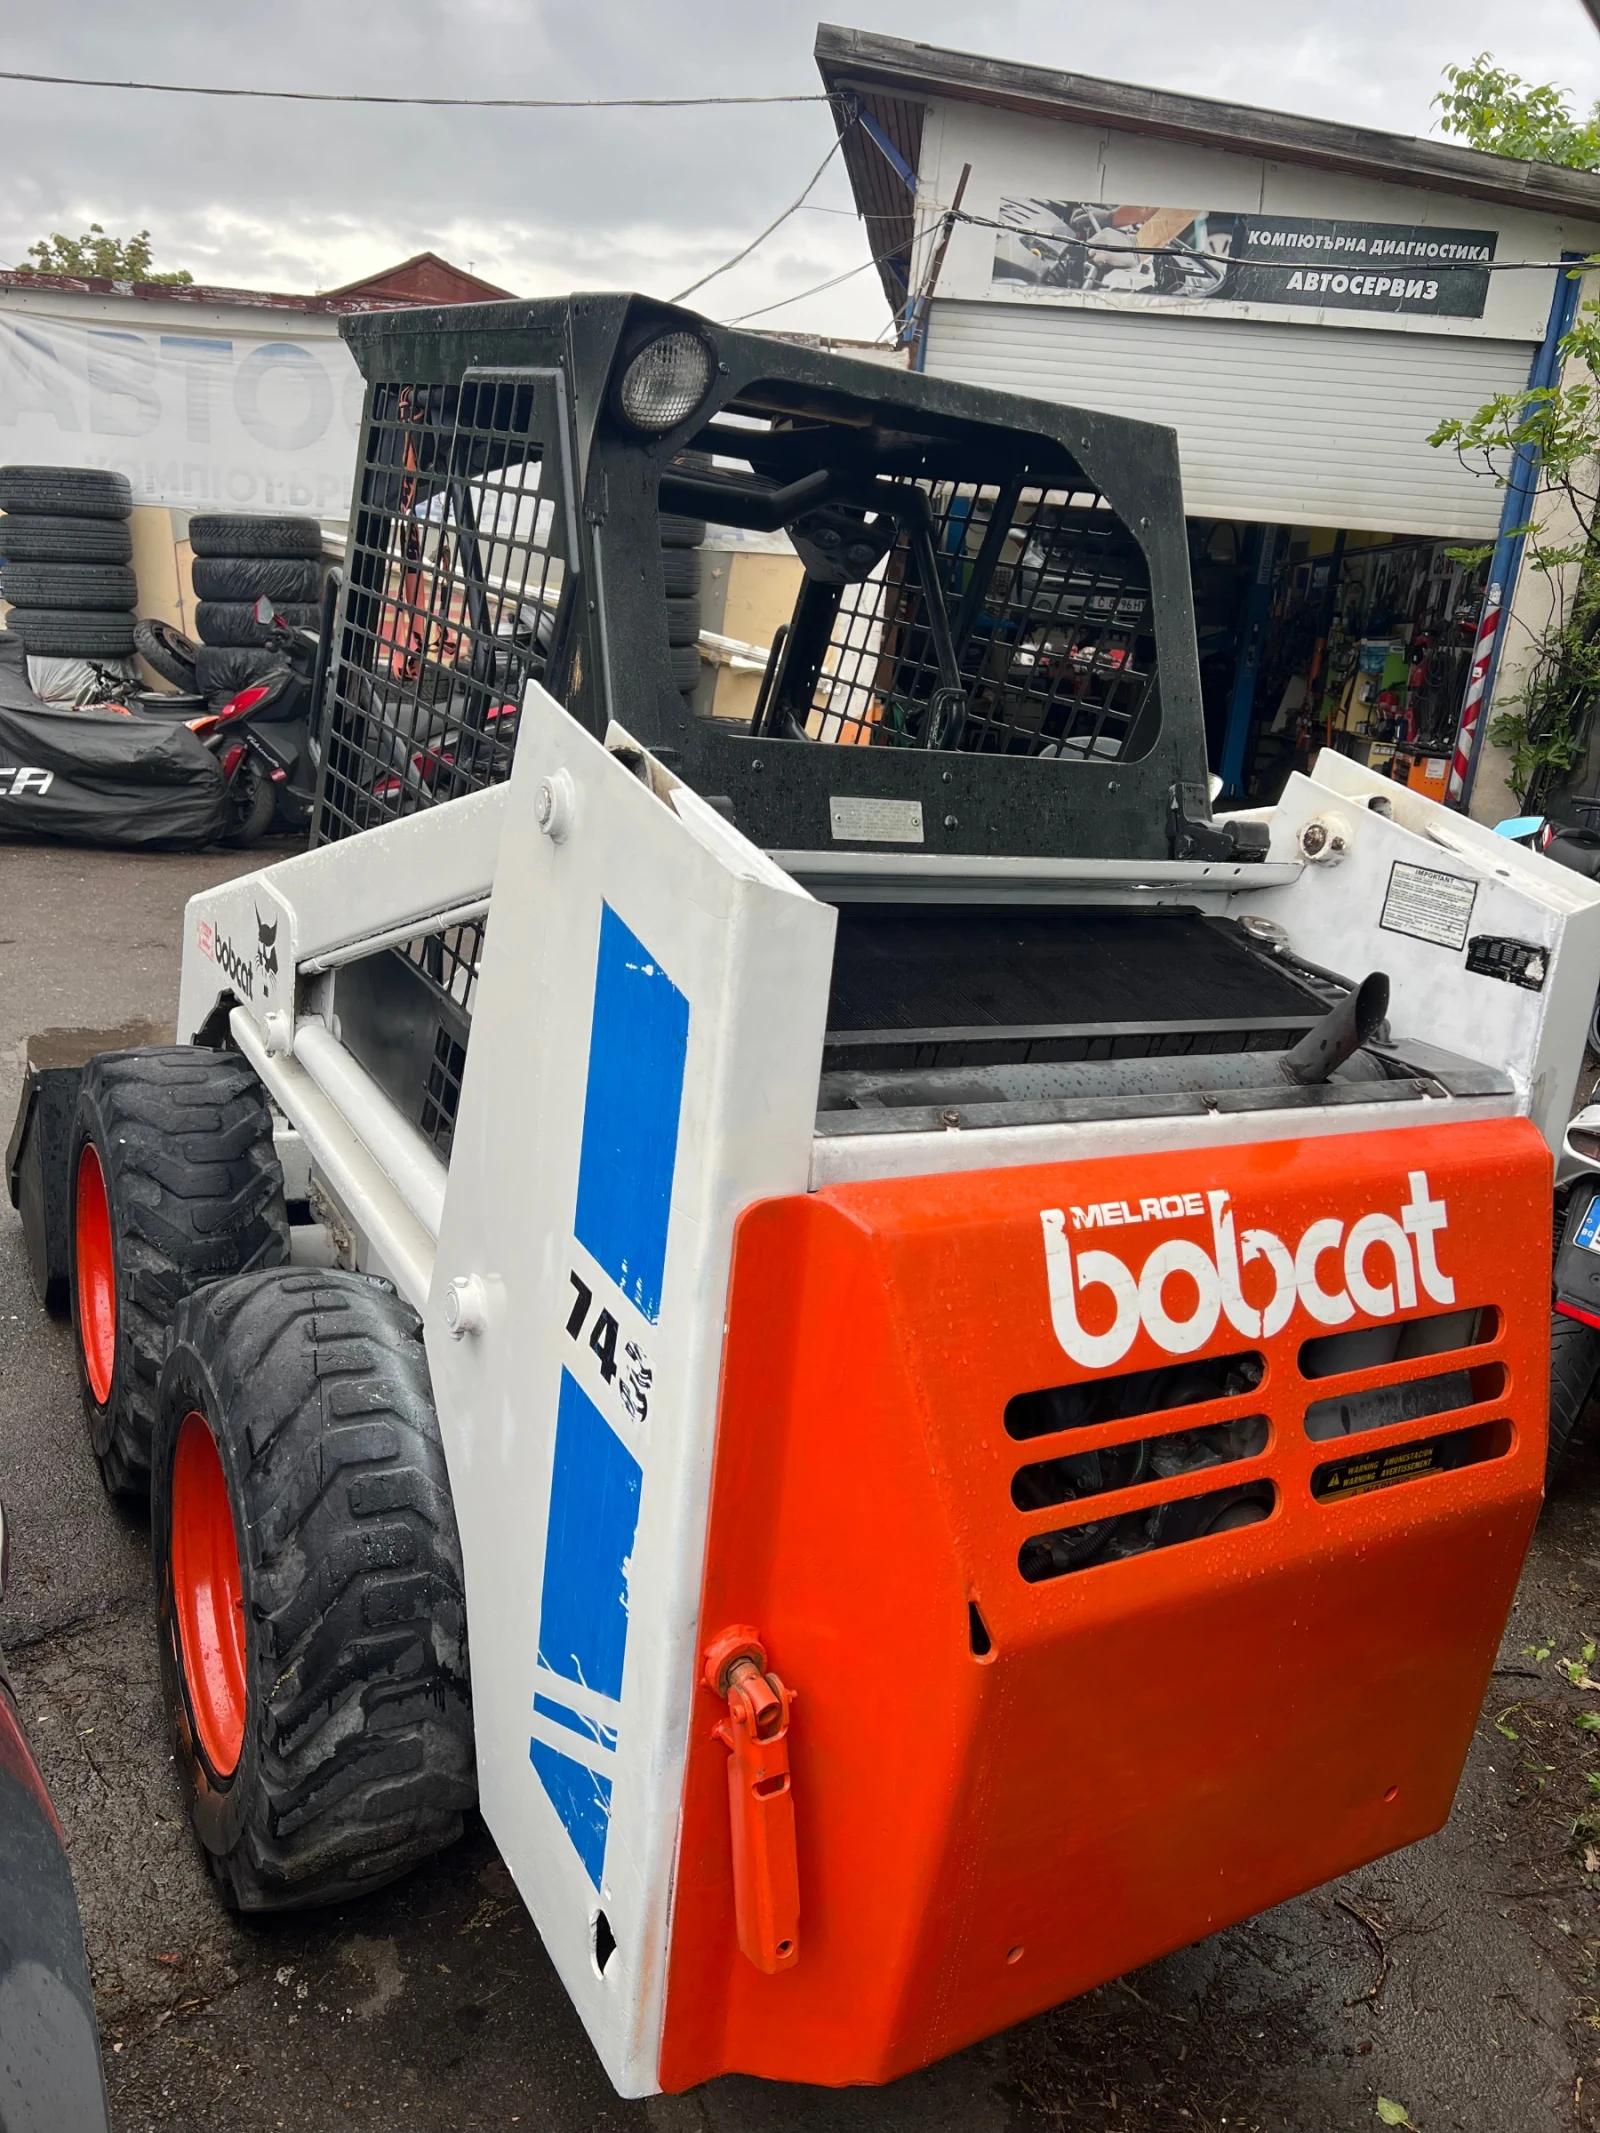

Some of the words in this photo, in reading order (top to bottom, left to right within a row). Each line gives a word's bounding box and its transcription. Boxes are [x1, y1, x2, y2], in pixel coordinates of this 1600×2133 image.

[1248, 230, 1366, 252] КОМПЮТЪРНА
[1369, 239, 1490, 261] ДИАГНОСТИКА
[1286, 271, 1438, 300] АВТОСЕРВИЗ
[0, 327, 362, 451] АВТО
[1415, 869, 1455, 884] IMPORTANT
[215, 921, 253, 1001] bobcat
[1069, 1193, 1205, 1230] MELROE
[1581, 1228, 1594, 1238] BG
[1040, 1171, 1455, 1368] bobcat
[1347, 1461, 1379, 1475] WARNING
[1383, 1448, 1433, 1467] AMONESTACION
[1380, 1458, 1432, 1477] AVERTISSEMENT
